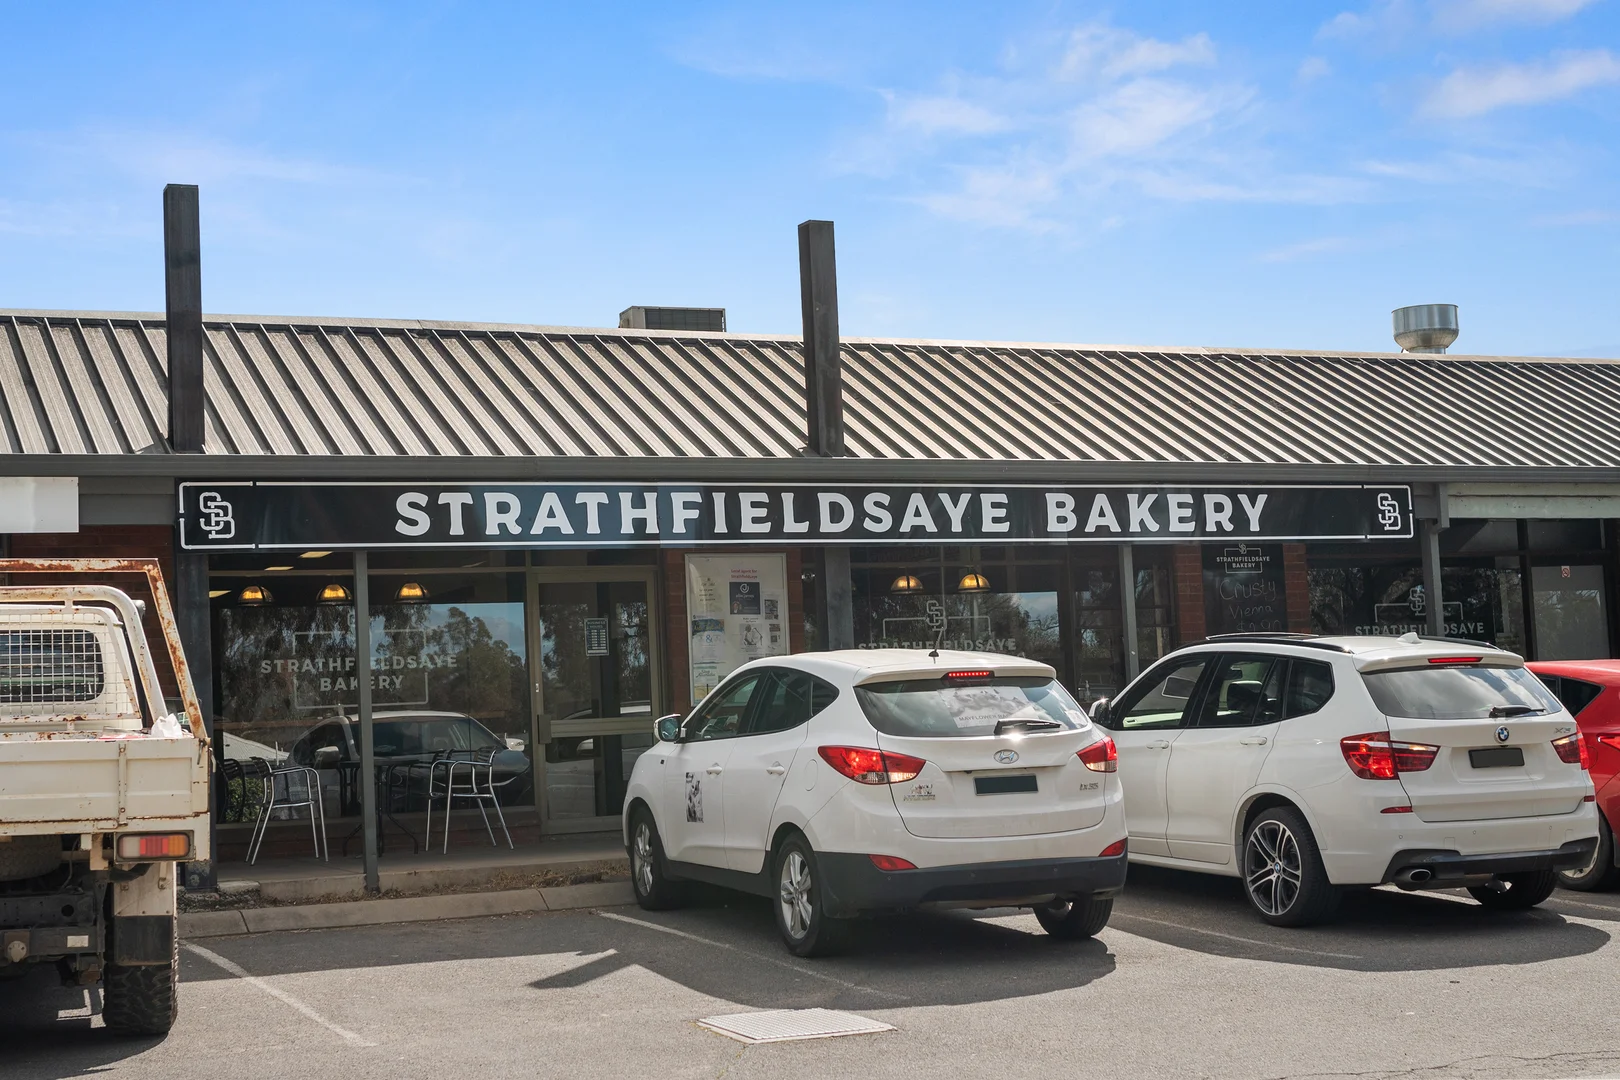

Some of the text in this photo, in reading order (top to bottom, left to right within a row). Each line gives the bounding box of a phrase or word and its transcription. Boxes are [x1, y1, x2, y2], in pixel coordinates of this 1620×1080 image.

[395, 491, 1269, 537] STRATHFIELDSAYE BAKERY
[1219, 578, 1277, 602] Crusty
[1229, 605, 1273, 619] Vienna
[1355, 622, 1485, 636] STRATHFIDSAYE
[260, 654, 458, 675] STRATHFELDSAYE
